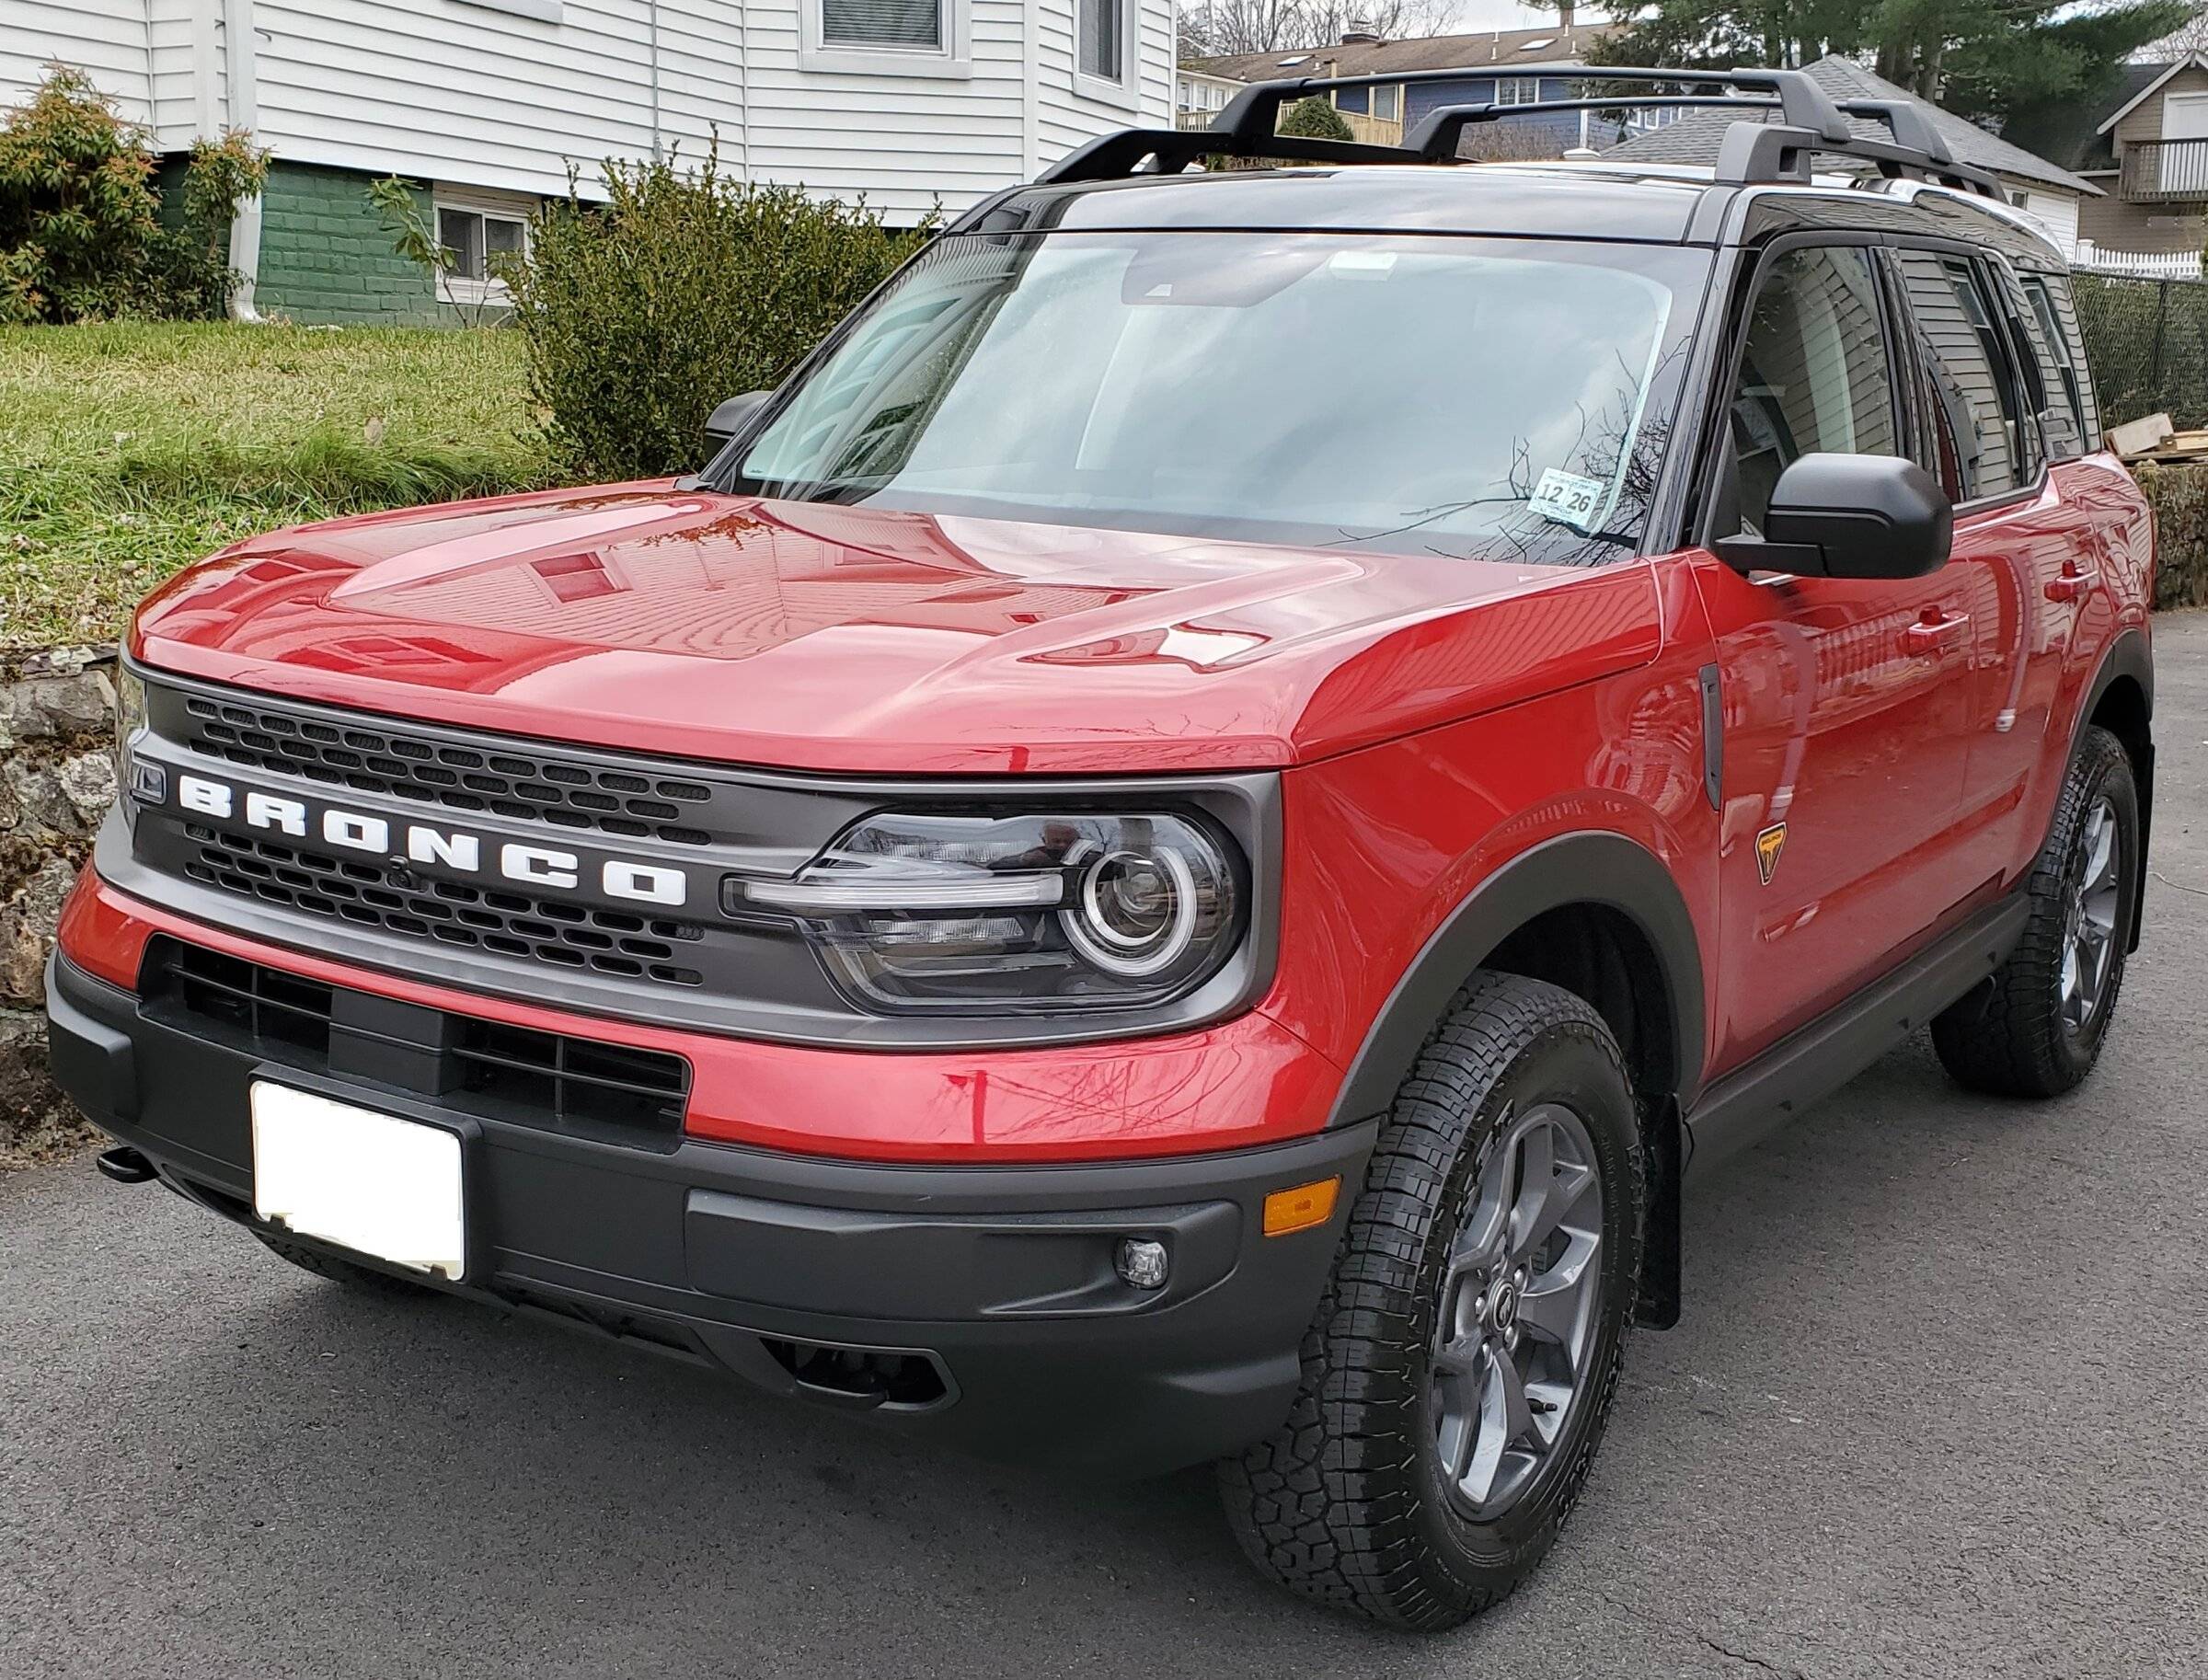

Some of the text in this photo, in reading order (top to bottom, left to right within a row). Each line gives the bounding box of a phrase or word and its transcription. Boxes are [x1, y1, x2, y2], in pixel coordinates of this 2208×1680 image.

[1538, 483, 1563, 503] 12
[1567, 492, 1591, 512] 26
[179, 775, 686, 906] BRONCO
